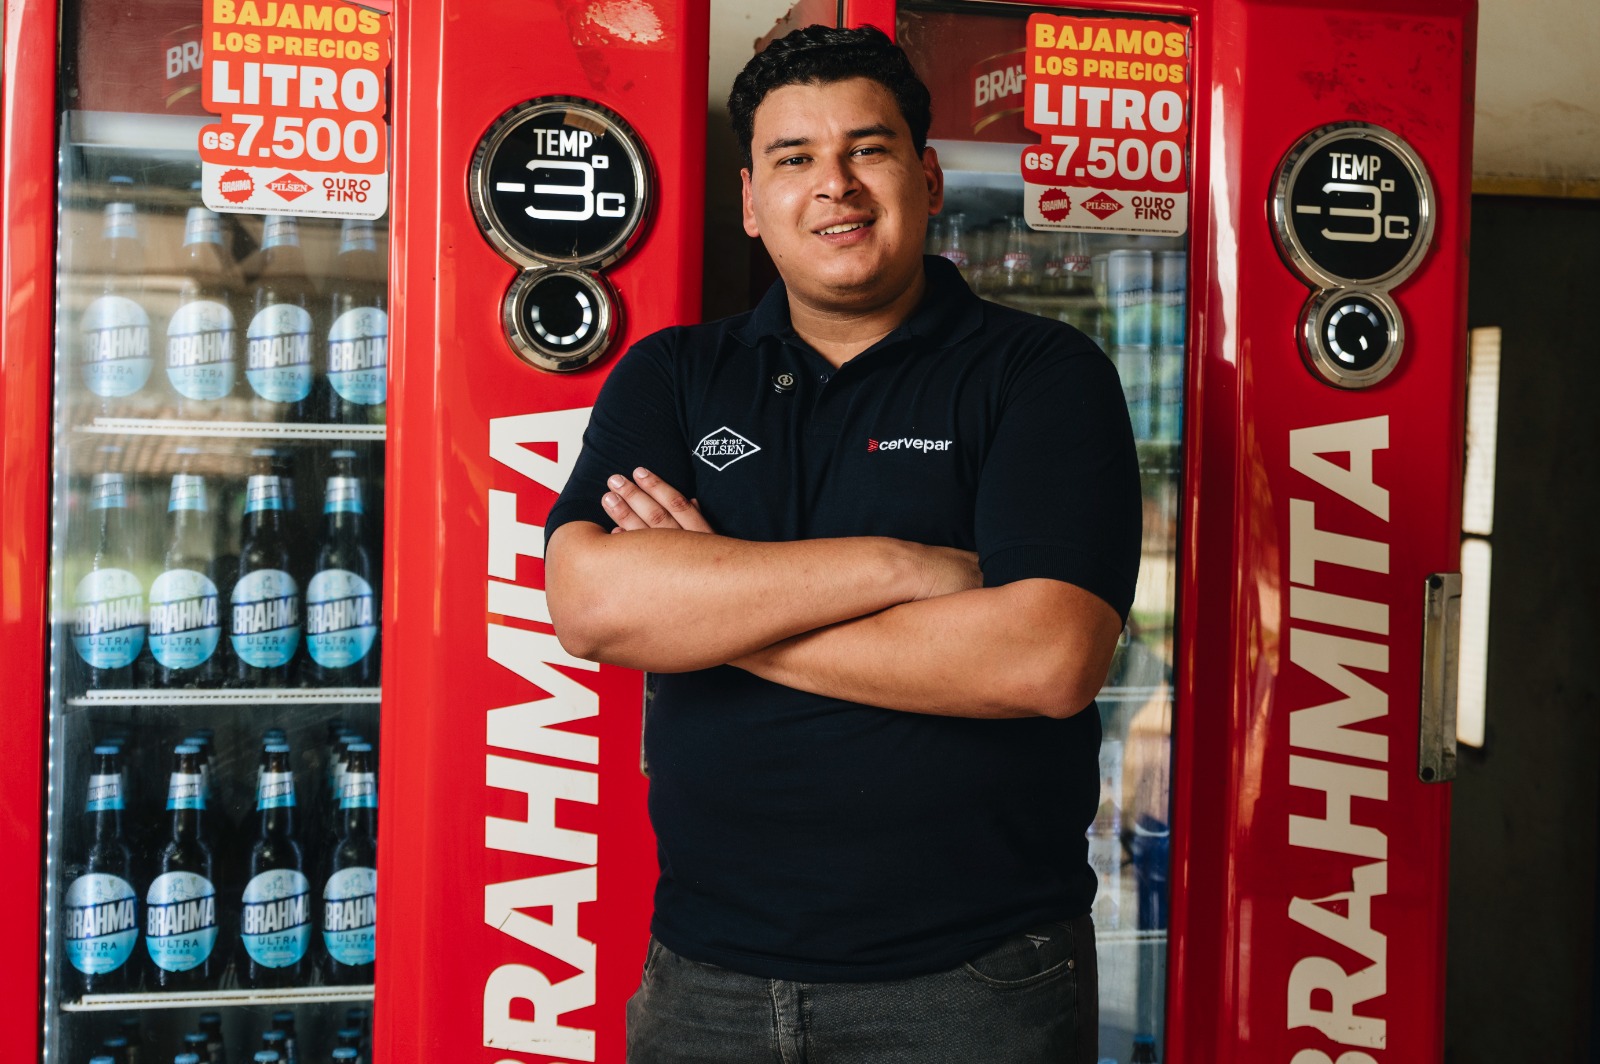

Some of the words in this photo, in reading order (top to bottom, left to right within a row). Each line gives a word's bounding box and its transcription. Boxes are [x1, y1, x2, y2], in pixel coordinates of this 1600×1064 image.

[213, 0, 381, 35] BAJAMOS
[212, 31, 261, 54] LOS
[267, 35, 380, 61] PRECIOS
[1035, 23, 1185, 58] BAJAMOS
[1034, 55, 1078, 77] LOS
[1083, 60, 1184, 84] PRECIOS
[212, 60, 380, 113] LITRO
[1033, 83, 1183, 133] LITRO
[231, 114, 379, 164] 7.500
[533, 128, 593, 158] TEMP
[1051, 135, 1182, 183] 7.500
[1329, 152, 1382, 181] TEMP
[221, 179, 251, 193] BRAHMA
[271, 182, 308, 193] PILSEN
[322, 177, 371, 193] OURO
[326, 190, 367, 203] FINO
[1131, 195, 1175, 211] OURO
[1042, 199, 1068, 212] BRAHMA
[1085, 201, 1119, 211] PILSEN
[1134, 208, 1172, 221] FINO
[169, 331, 233, 368] BRAHM
[249, 334, 309, 370] BRAHM
[331, 337, 387, 372] BRAHM
[92, 365, 134, 376] ULTRA
[184, 368, 224, 379] ULTRA
[263, 371, 304, 382] ULTRA
[346, 373, 385, 383] ULTRA
[701, 445, 745, 457] PILSEN
[879, 437, 953, 454] cervepar
[150, 596, 218, 635] BRAHMA
[307, 596, 373, 634] BRAHMA
[88, 636, 131, 646] ULTRA
[161, 636, 201, 646] ULTRA
[246, 635, 289, 645] ULTRA
[317, 635, 356, 645] ULTRA
[482, 407, 598, 1064] RAHMITA
[1287, 415, 1391, 1064] RAHMITA
[66, 899, 135, 939] BRAHMA
[147, 896, 215, 937] BRAHMA
[325, 895, 376, 931] BRAHM
[158, 939, 199, 949] ULTRA
[258, 935, 298, 946] ULTRA
[336, 933, 375, 943] ULTRA
[75, 942, 117, 951] ULTRA
